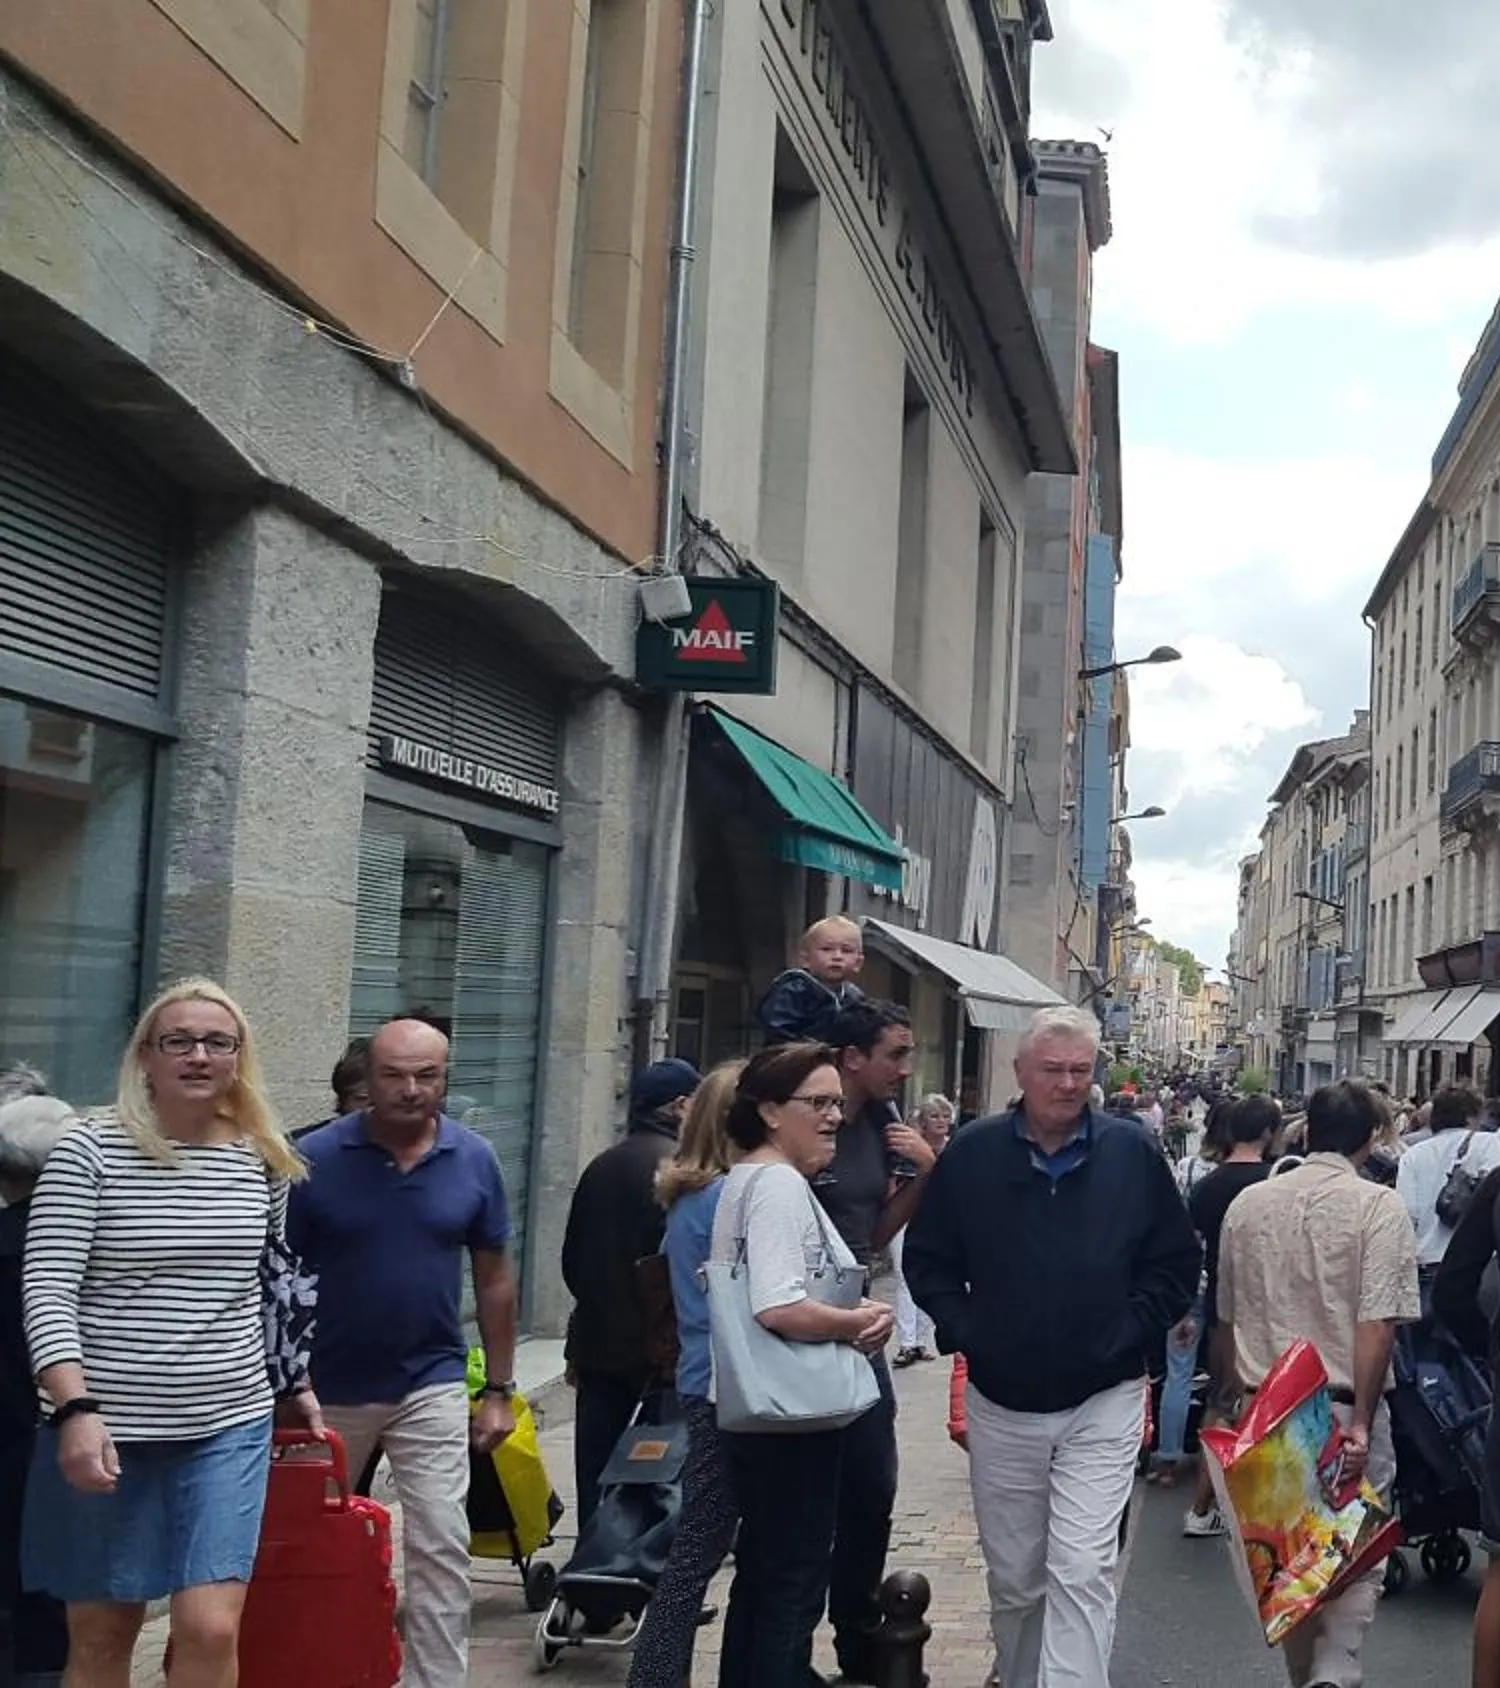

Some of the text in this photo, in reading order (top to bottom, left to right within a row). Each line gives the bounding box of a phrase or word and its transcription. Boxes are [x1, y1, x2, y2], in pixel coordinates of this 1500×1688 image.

[672, 627, 755, 650] MAIF
[392, 735, 560, 814] MUTUELLE D'ASSURANCE
